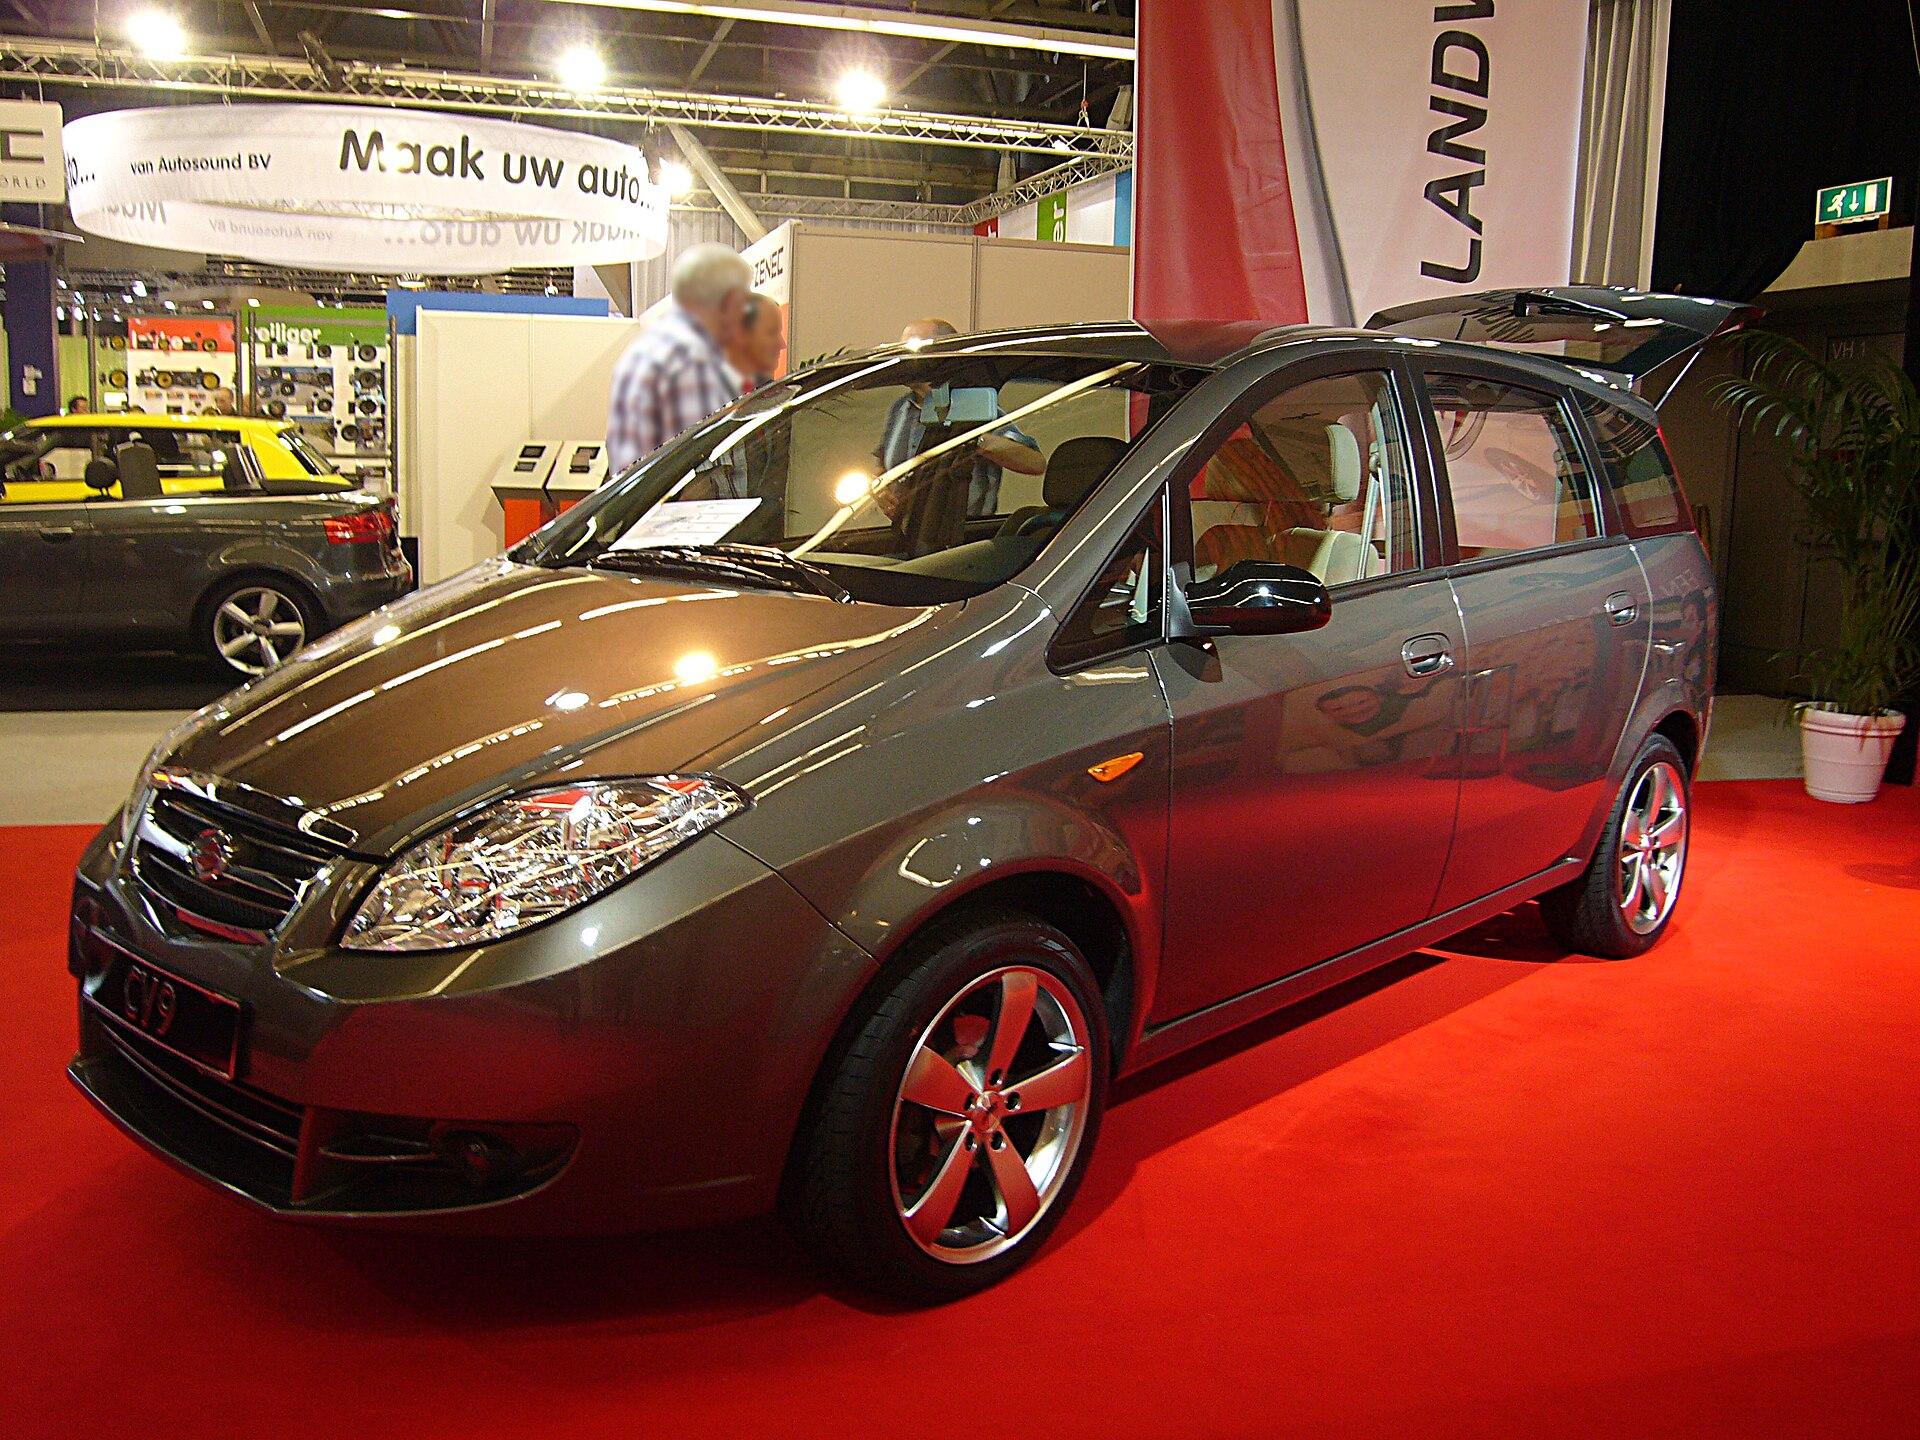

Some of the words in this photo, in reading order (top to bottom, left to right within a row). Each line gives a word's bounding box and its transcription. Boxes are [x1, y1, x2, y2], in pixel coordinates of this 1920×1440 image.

[130, 160, 154, 176] van
[158, 152, 242, 174] Autosound
[248, 152, 272, 170] BV
[339, 128, 485, 181] Maak
[503, 152, 565, 189] uw
